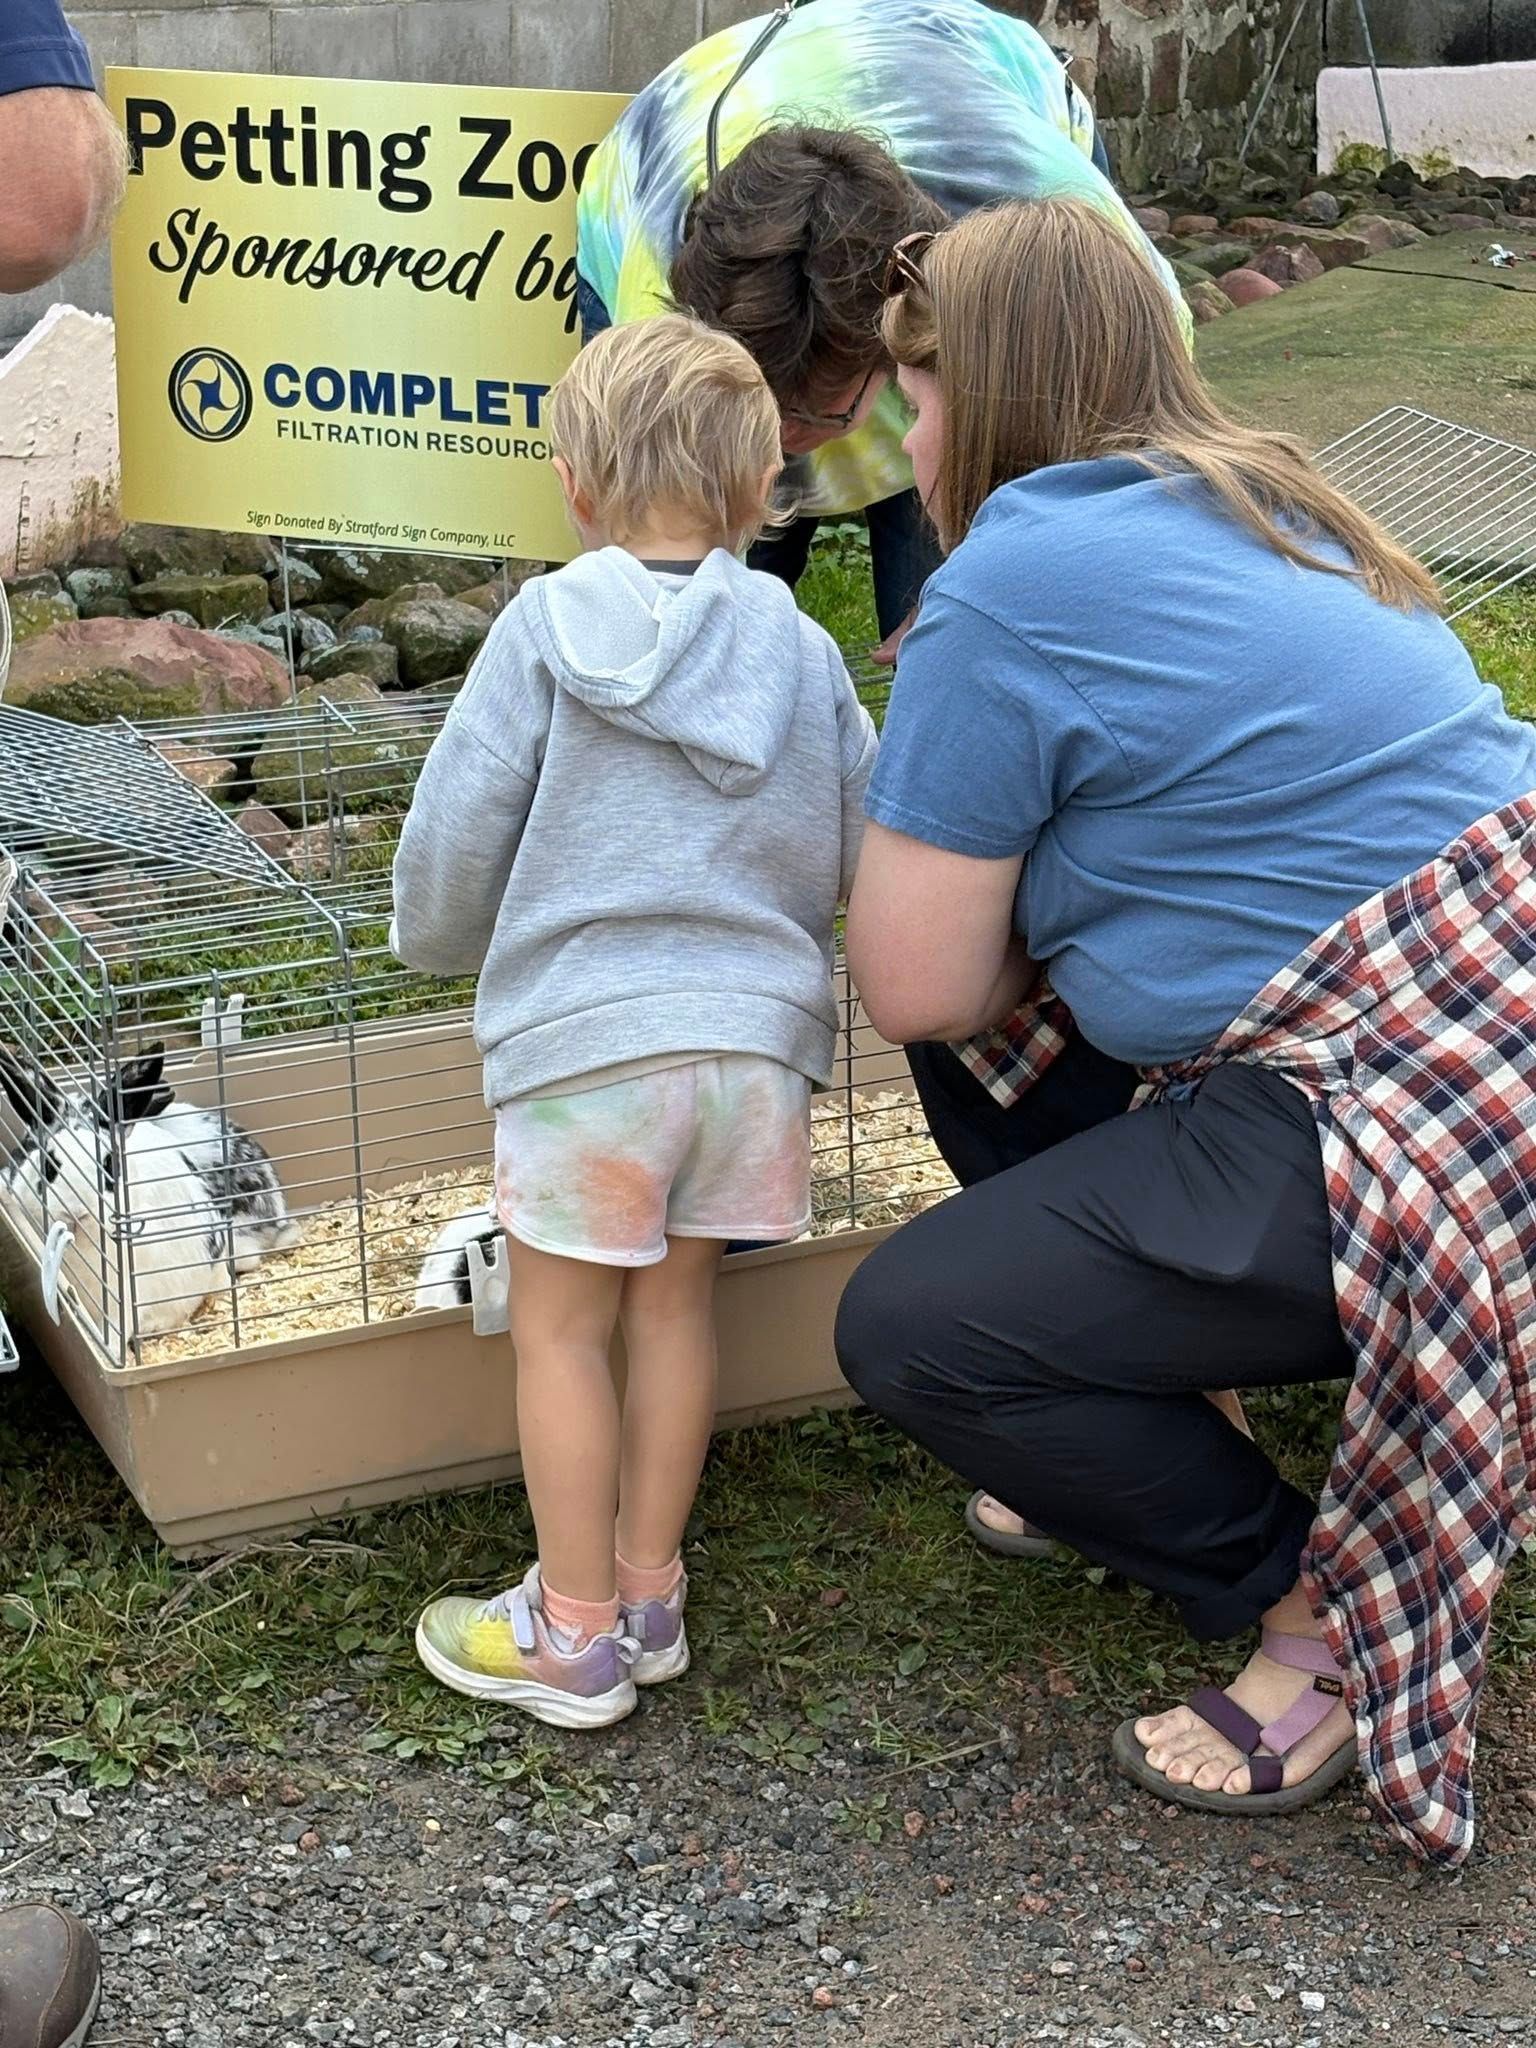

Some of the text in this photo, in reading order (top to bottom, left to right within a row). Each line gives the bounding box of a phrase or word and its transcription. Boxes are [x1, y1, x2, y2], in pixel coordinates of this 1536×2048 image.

[125, 97, 432, 213] Petting
[149, 207, 505, 304] Sponsored
[277, 419, 418, 450] FILTRATION
[246, 511, 516, 548] Sign Donated By Stratford Sign Company, LLC
